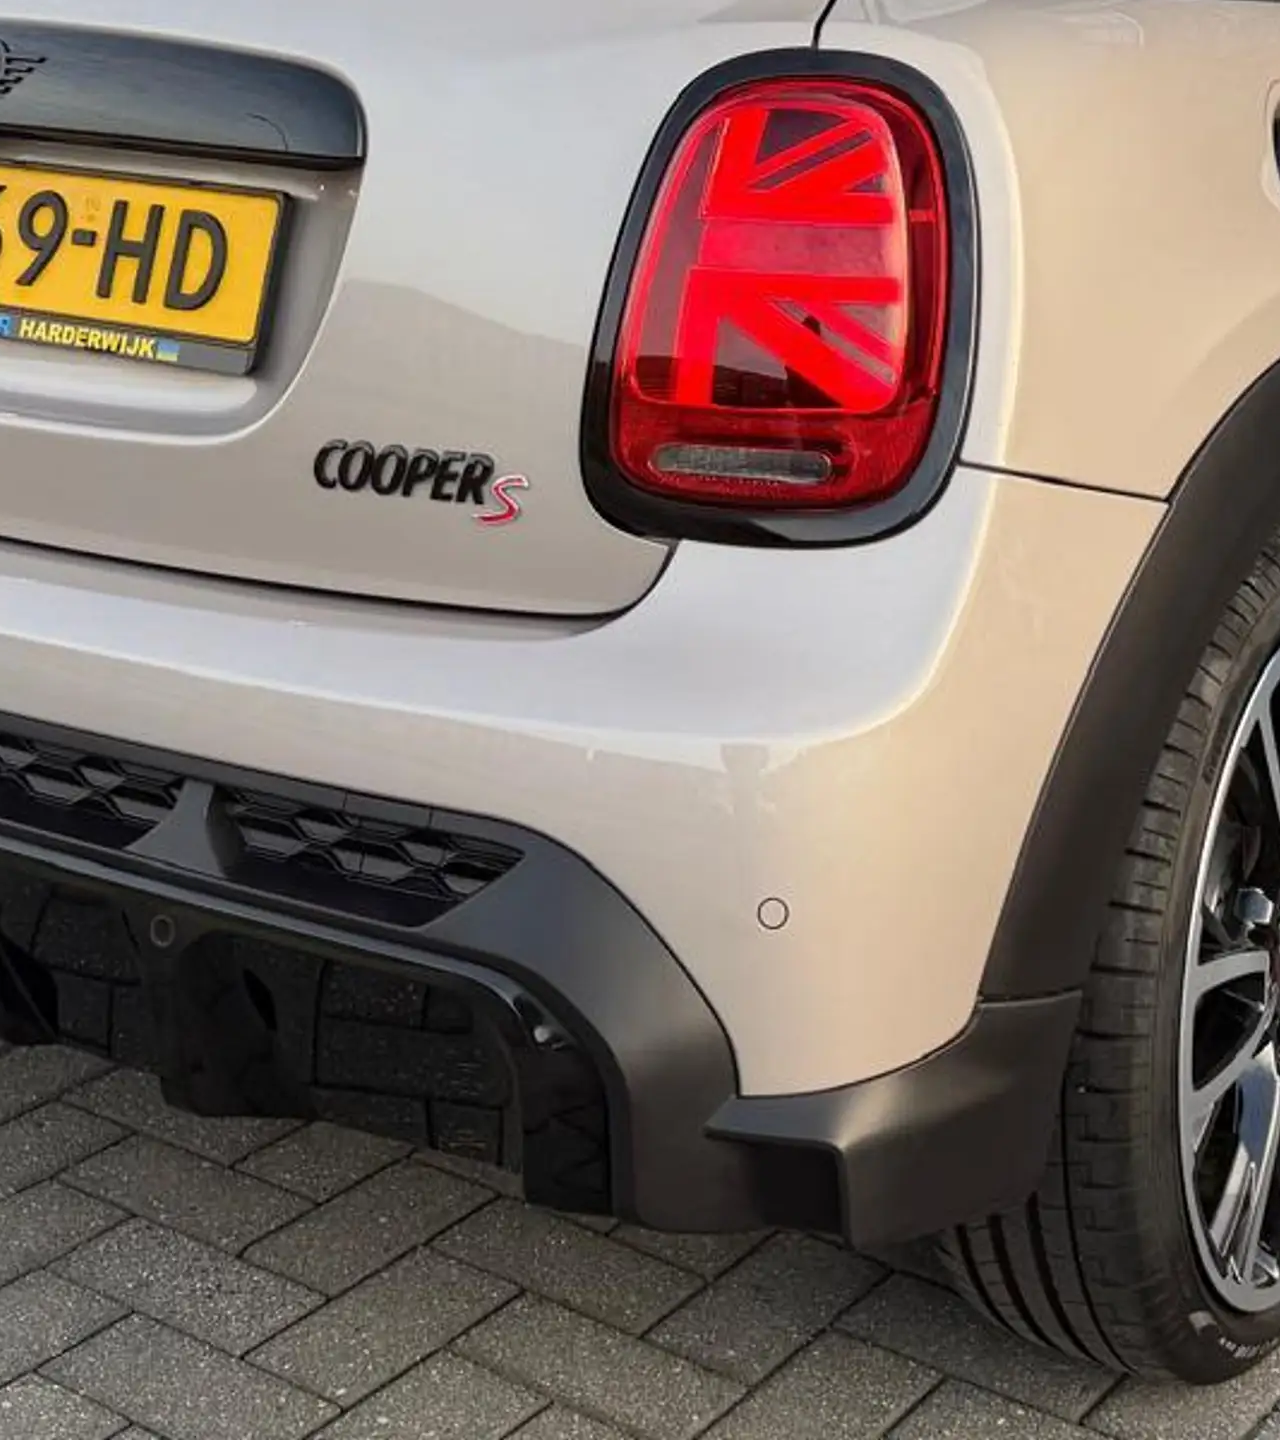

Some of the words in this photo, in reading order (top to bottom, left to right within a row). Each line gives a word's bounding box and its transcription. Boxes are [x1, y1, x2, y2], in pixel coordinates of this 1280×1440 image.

[19, 318, 156, 359] HARDERWIJK
[314, 439, 494, 505] COOPER
[472, 474, 529, 526] S
